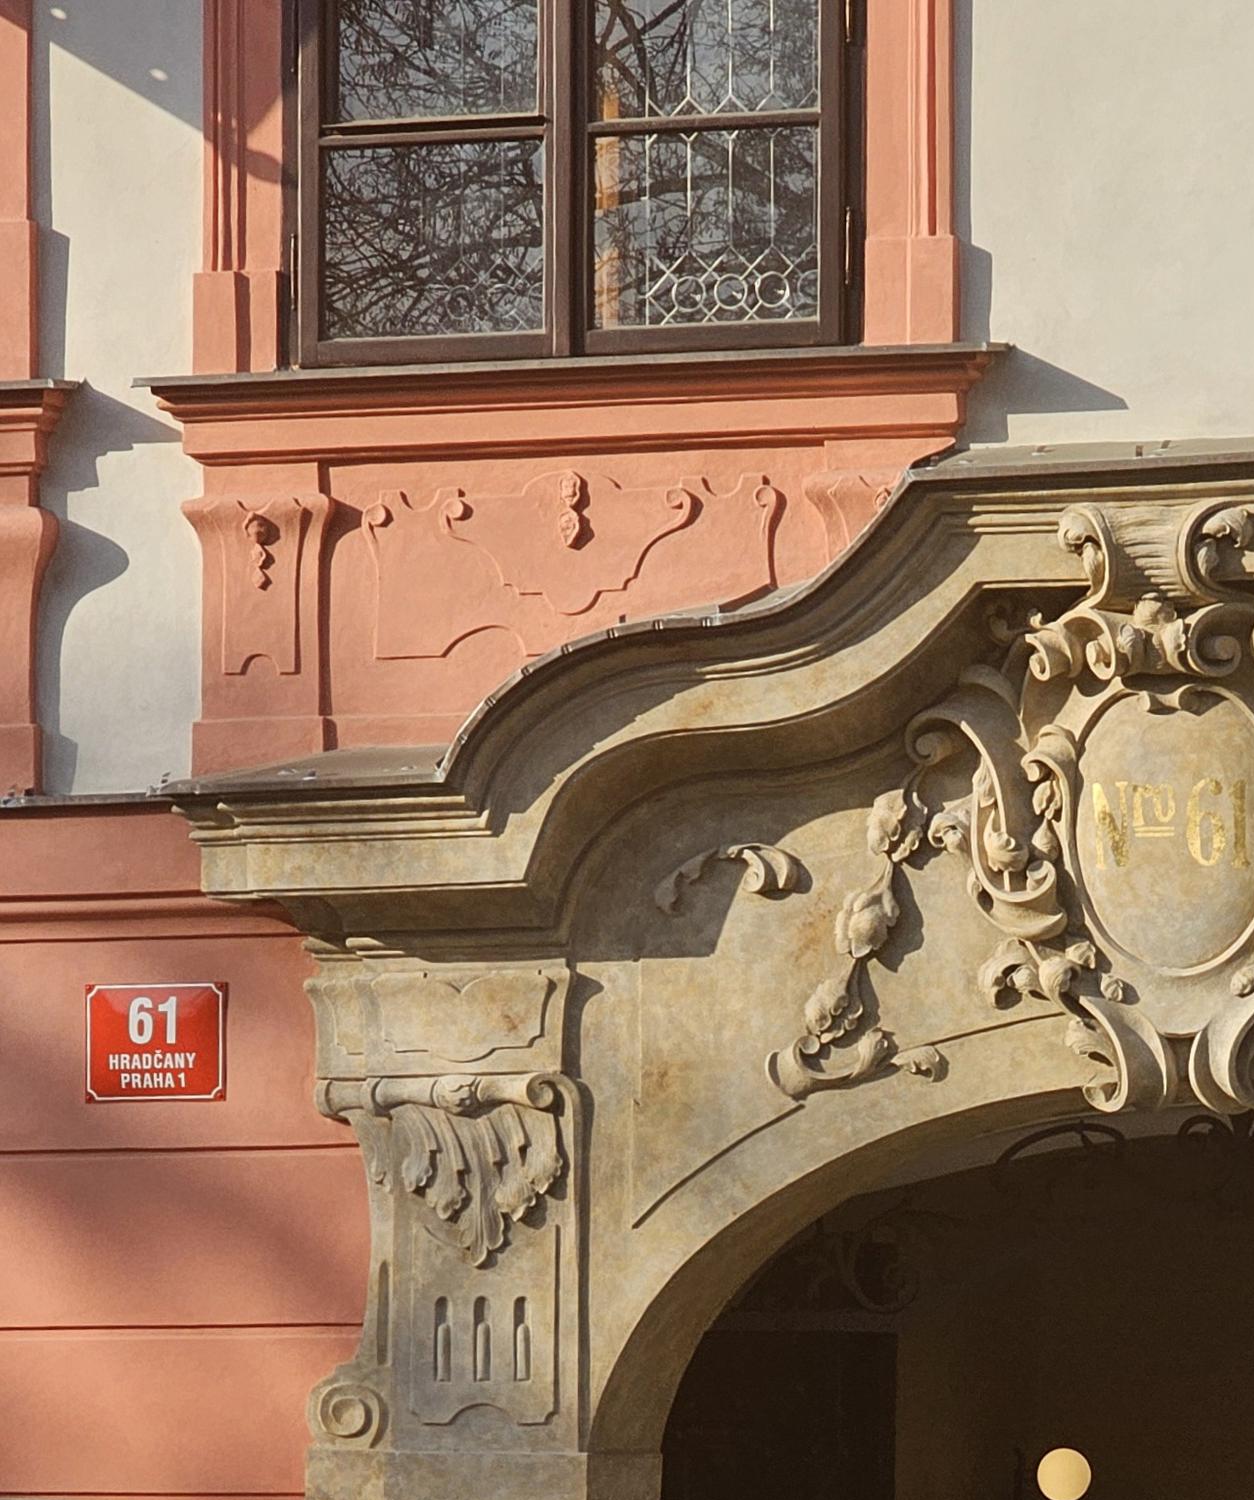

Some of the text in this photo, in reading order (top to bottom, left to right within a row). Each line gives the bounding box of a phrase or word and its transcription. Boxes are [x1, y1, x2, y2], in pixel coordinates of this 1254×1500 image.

[1186, 777, 1250, 869] 61
[128, 995, 178, 1045] 61
[108, 1049, 197, 1071] HRADČANY
[120, 1072, 186, 1089] PRAHA 1
